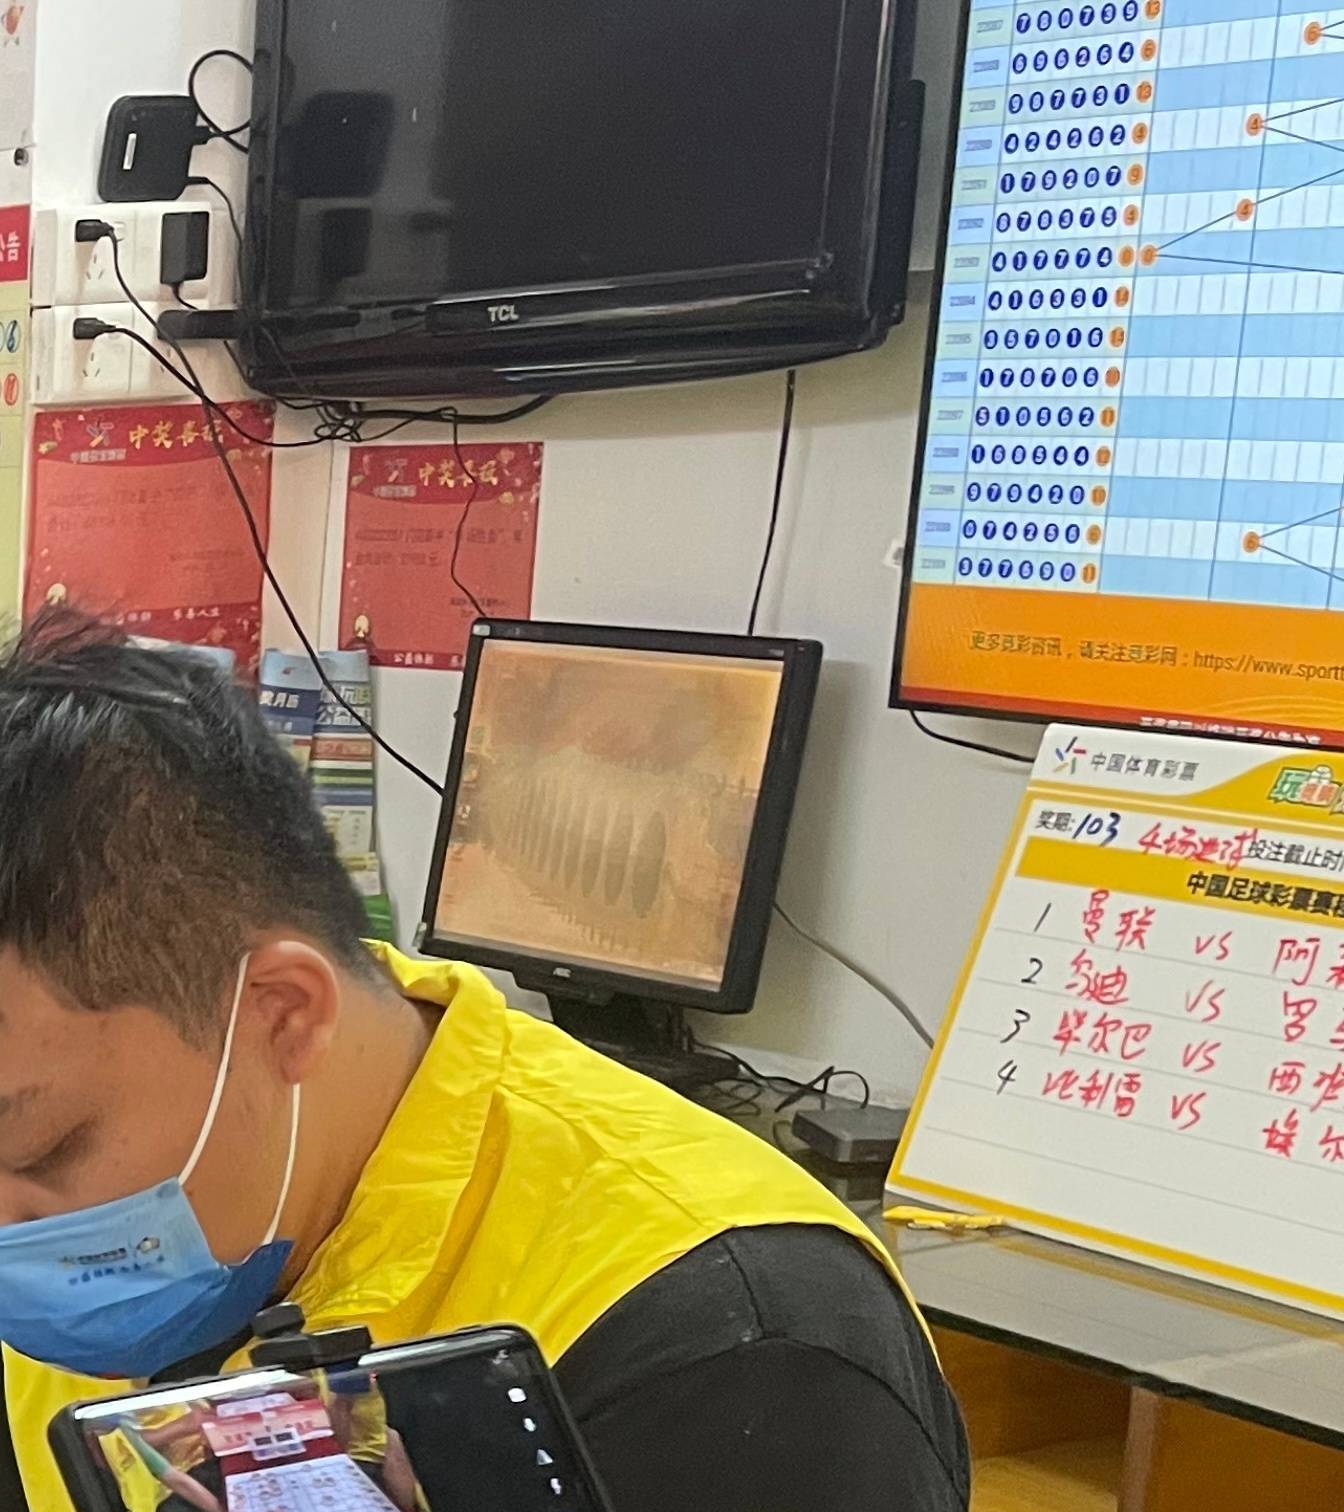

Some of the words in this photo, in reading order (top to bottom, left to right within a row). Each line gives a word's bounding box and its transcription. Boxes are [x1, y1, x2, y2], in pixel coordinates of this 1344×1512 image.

[487, 305, 520, 325] TCL
[1089, 751, 1200, 783] 中国体育彩票
[1072, 811, 1122, 848] 103
[1032, 901, 1052, 934] 1
[1080, 888, 1157, 951] 曼联
[1020, 956, 1045, 986] 2
[999, 1008, 1033, 1045] 3
[996, 1058, 1017, 1095] 4
